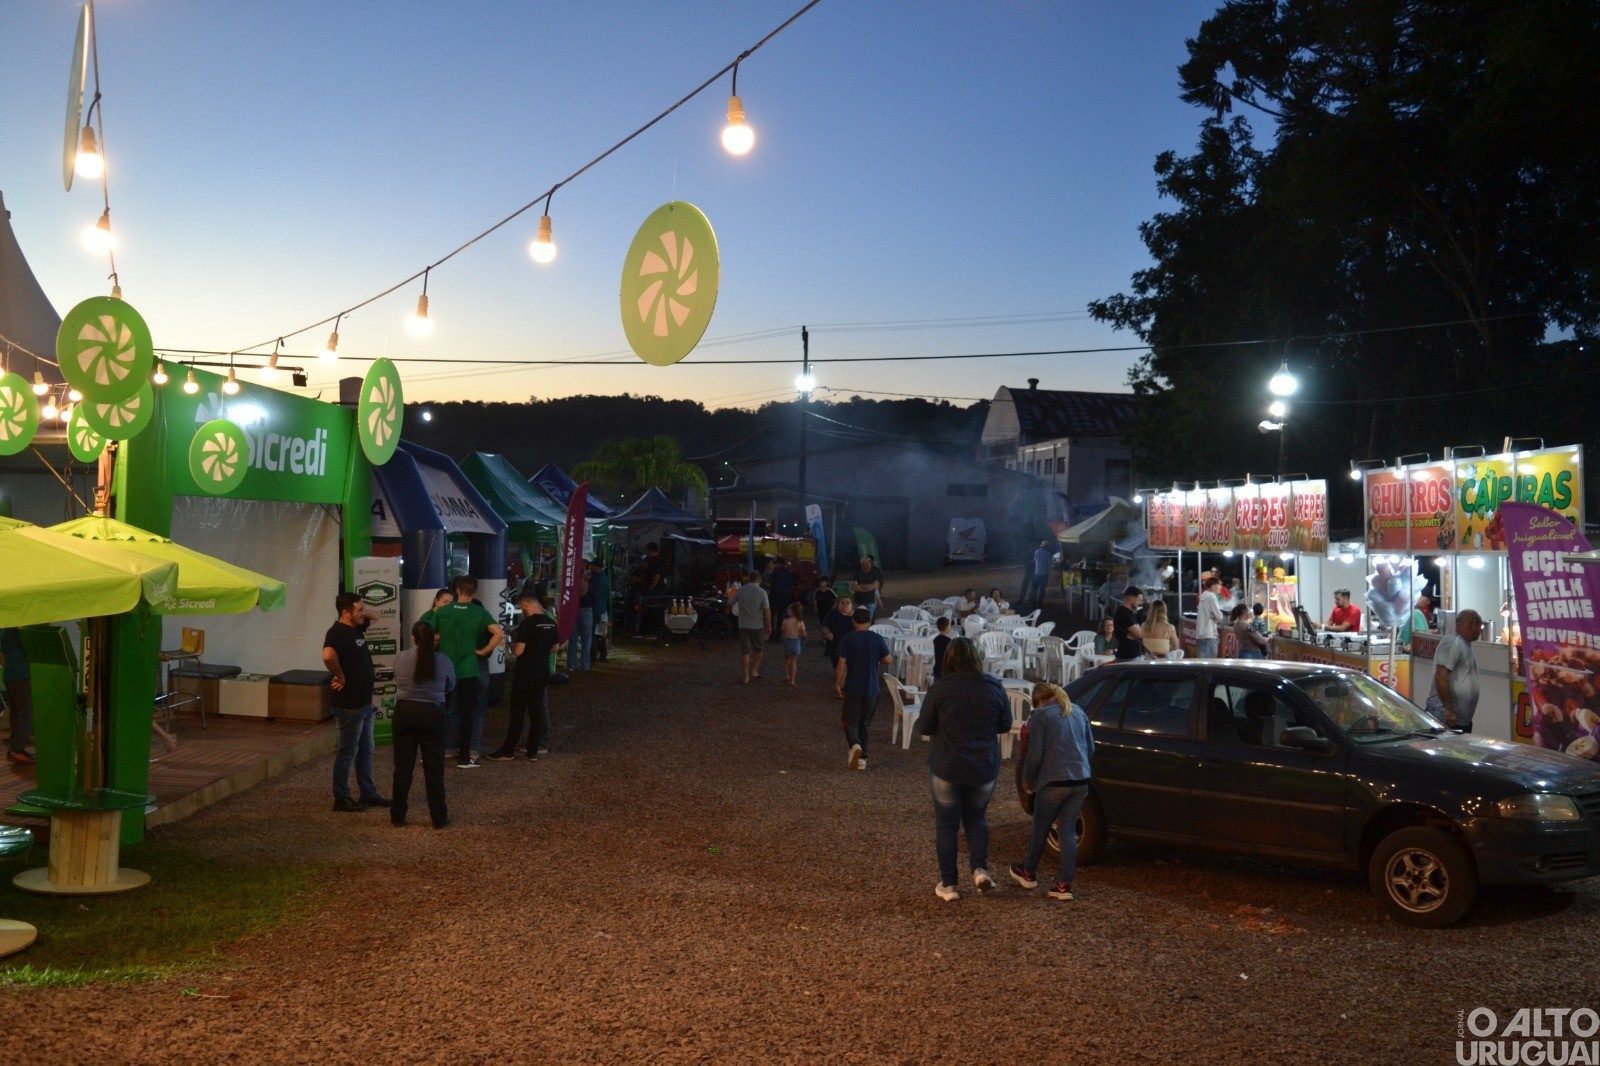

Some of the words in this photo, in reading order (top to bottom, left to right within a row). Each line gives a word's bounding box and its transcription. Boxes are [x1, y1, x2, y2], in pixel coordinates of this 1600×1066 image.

[1370, 478, 1451, 516] CHURROS
[1460, 470, 1573, 514] CAIPIRAS
[1235, 496, 1288, 531] CREPES
[1293, 493, 1327, 521] CREPES
[1529, 516, 1562, 530] Sabor
[565, 516, 576, 587] BREVANT
[1524, 578, 1584, 601] MILK
[178, 599, 216, 609] Sicredi
[1526, 599, 1595, 622] SHAKE
[1526, 626, 1600, 650] SORVETES
